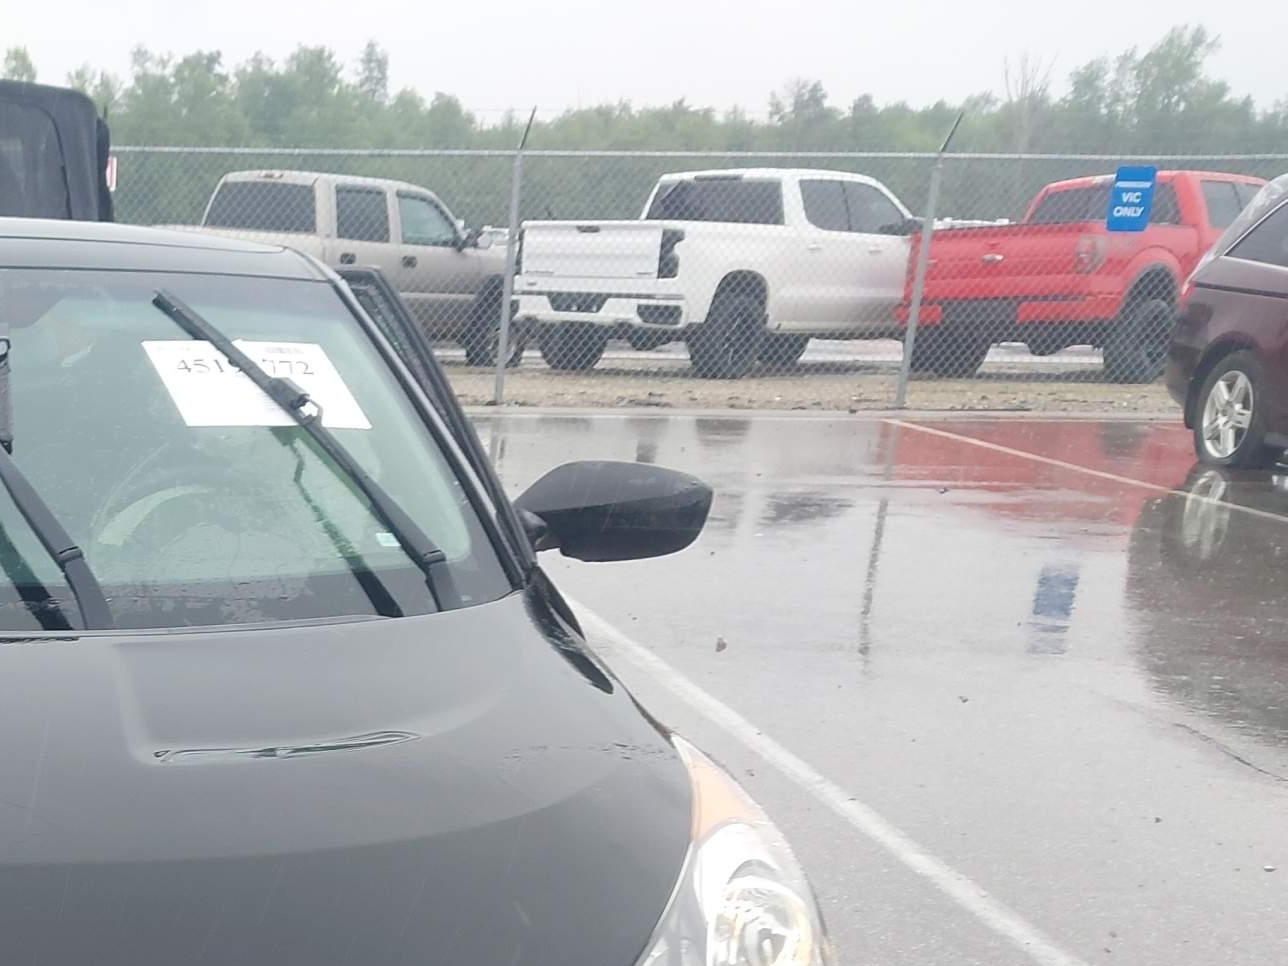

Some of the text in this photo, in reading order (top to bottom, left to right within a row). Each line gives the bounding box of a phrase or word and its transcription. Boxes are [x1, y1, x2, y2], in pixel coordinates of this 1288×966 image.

[1122, 191, 1143, 203] VIC
[1113, 206, 1145, 217] ONLY
[176, 359, 315, 375] 451772
